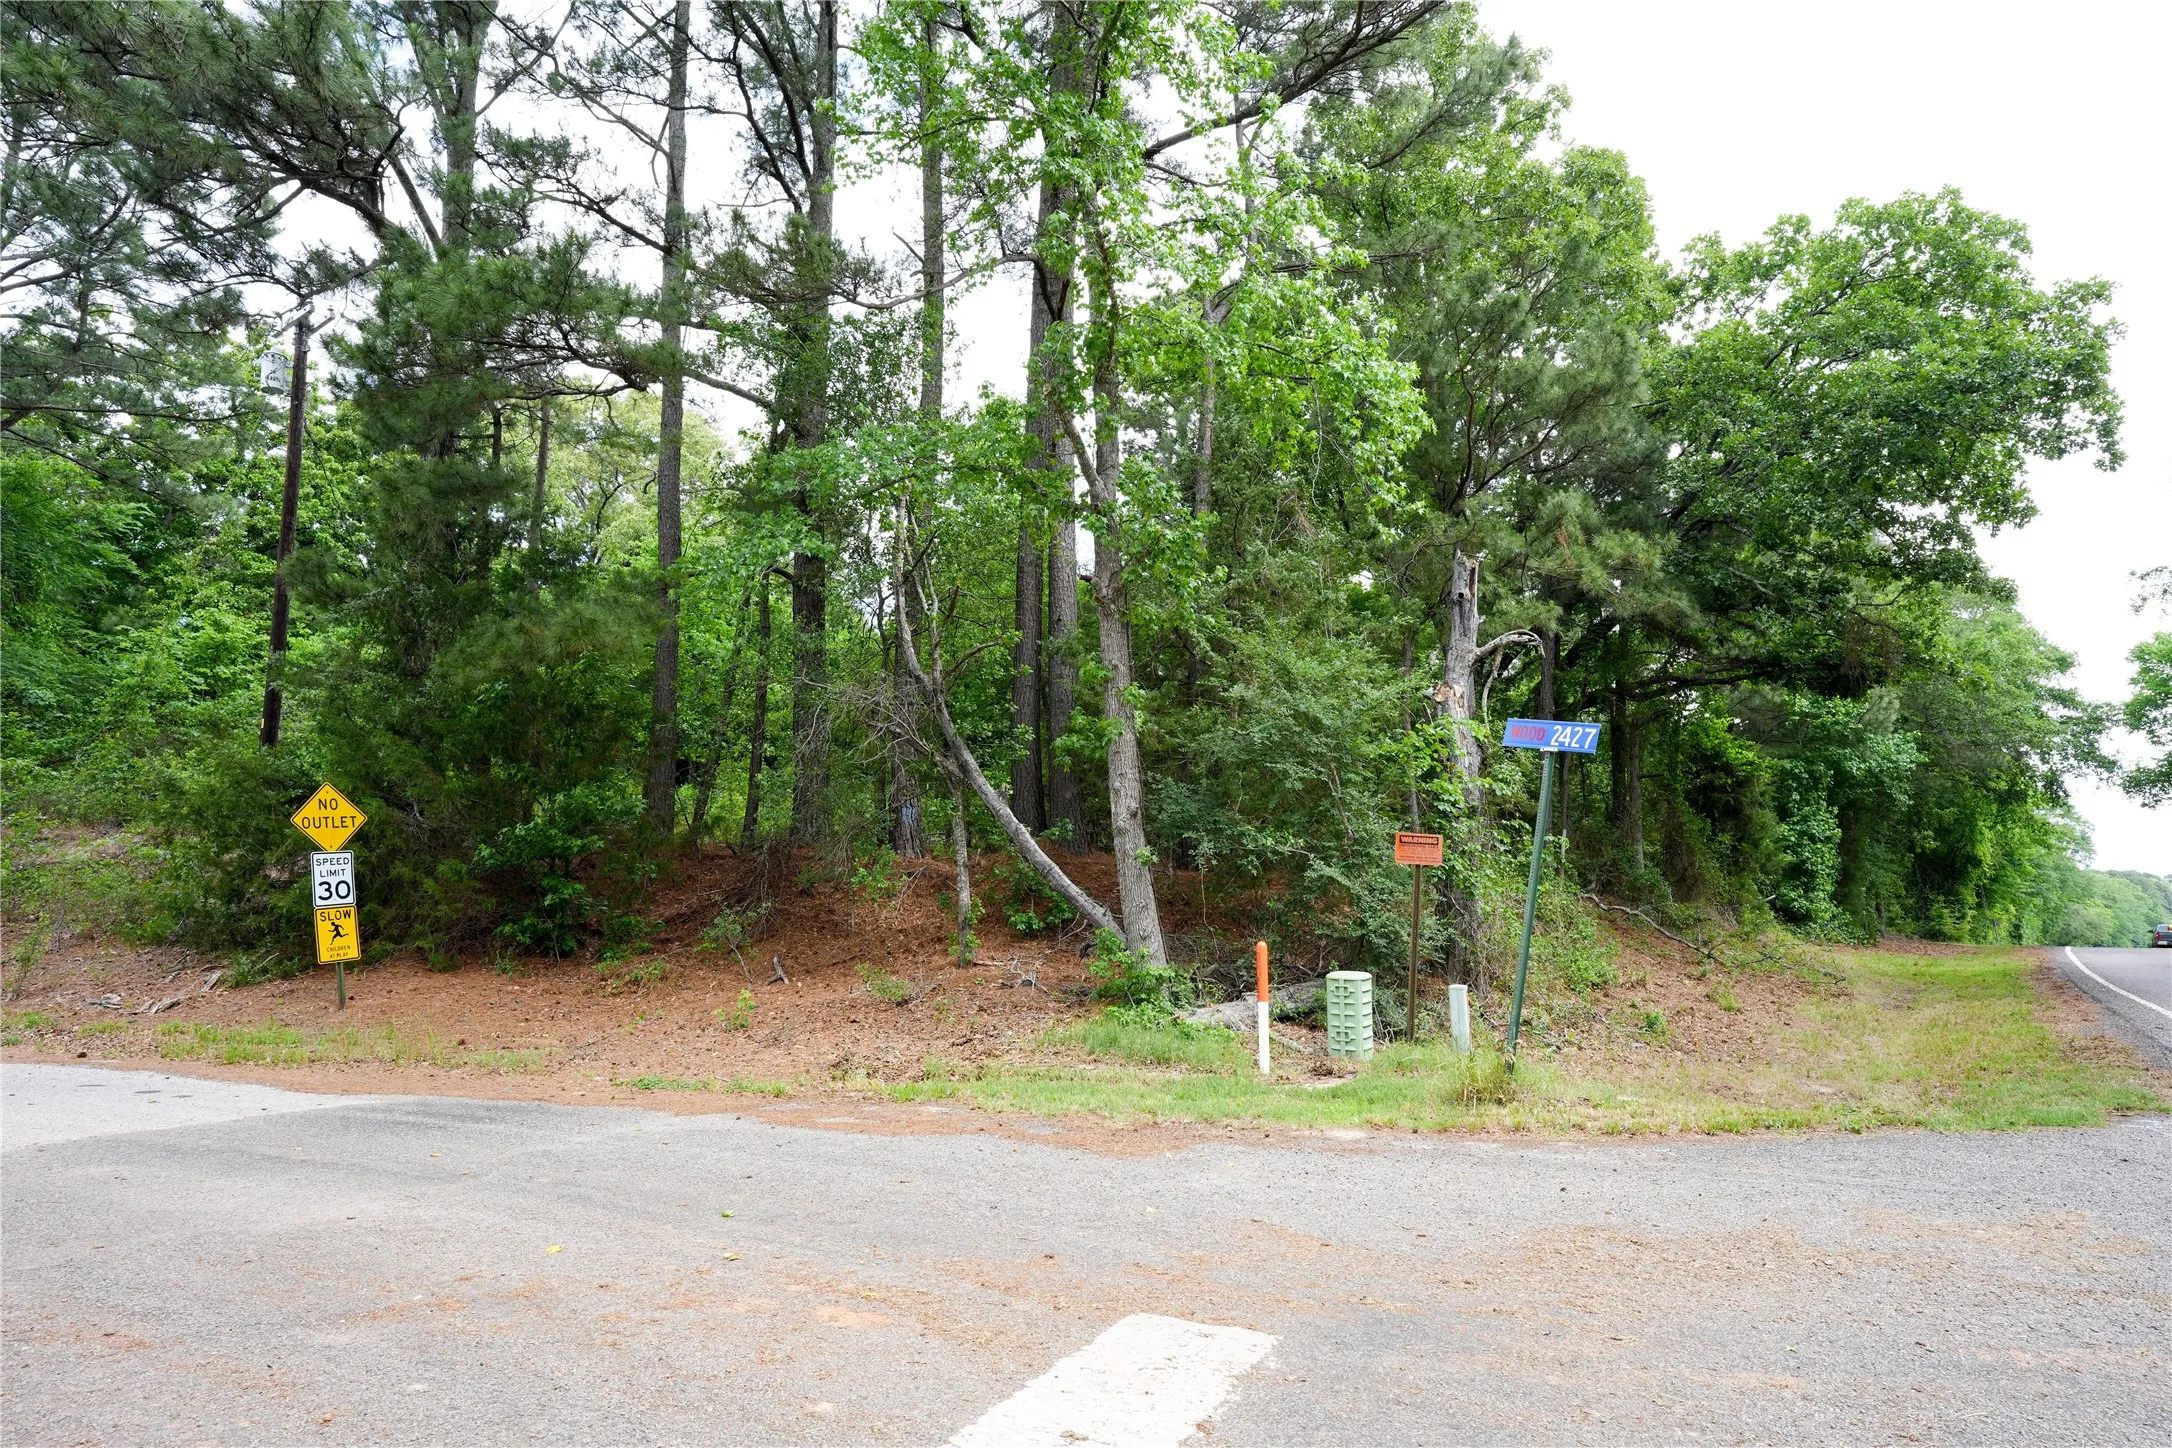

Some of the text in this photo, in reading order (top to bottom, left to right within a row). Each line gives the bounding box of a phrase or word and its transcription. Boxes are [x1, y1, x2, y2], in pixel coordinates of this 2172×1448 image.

[1511, 724, 1598, 749] WOOD 2427
[318, 798, 339, 811] NO
[301, 815, 357, 830] OUTLET
[1401, 836, 1438, 845] WARNING
[316, 857, 350, 866] SPEED
[320, 868, 346, 877] LIMIT
[318, 880, 351, 901] 30
[320, 909, 352, 922] SLOW
